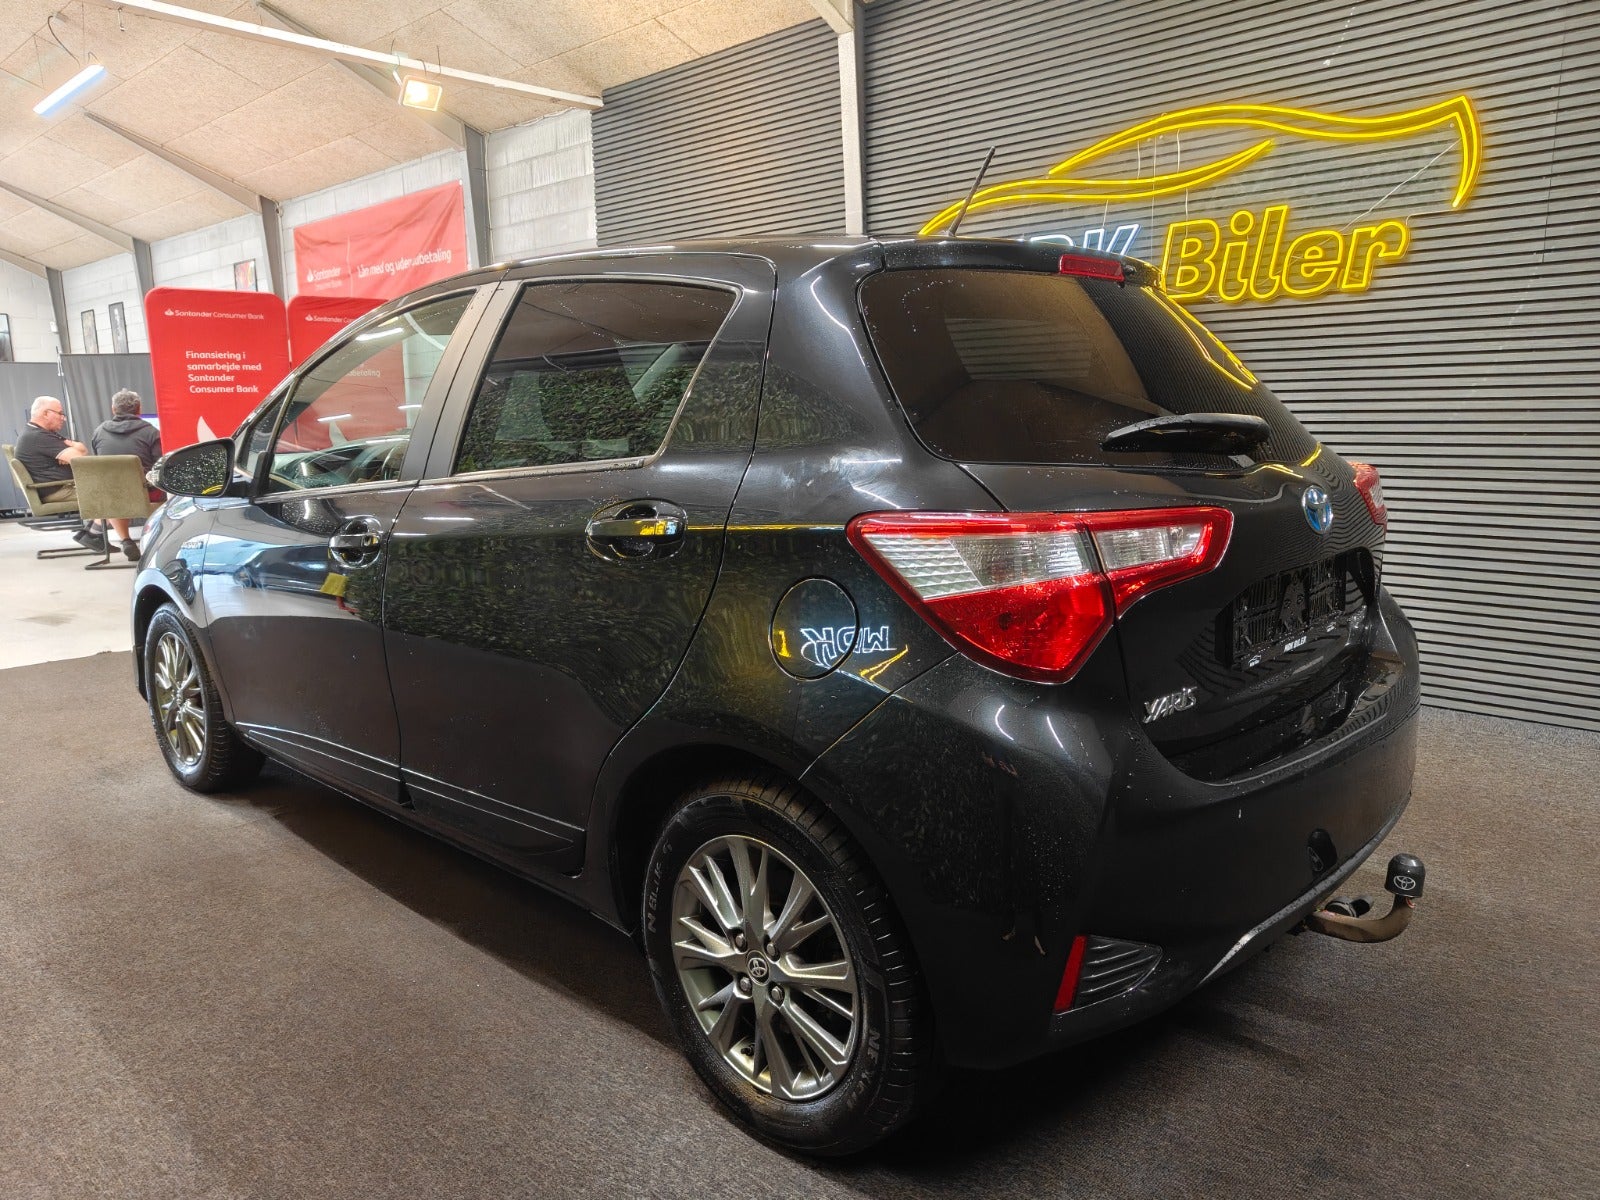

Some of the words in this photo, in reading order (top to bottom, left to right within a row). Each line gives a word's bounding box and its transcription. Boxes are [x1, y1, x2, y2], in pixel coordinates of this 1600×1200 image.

[1160, 204, 1408, 301] Biler
[385, 261, 395, 276] og
[175, 309, 212, 318] Santander
[213, 311, 247, 319] Consumer
[247, 312, 264, 320] Bank
[313, 314, 343, 323] Santander
[185, 350, 241, 361] Finansiering
[242, 351, 246, 359] i
[187, 362, 241, 372] samarbejde
[242, 363, 262, 371] med
[187, 373, 235, 382] Santander
[189, 385, 235, 393] Consumer
[236, 384, 259, 393] Bank
